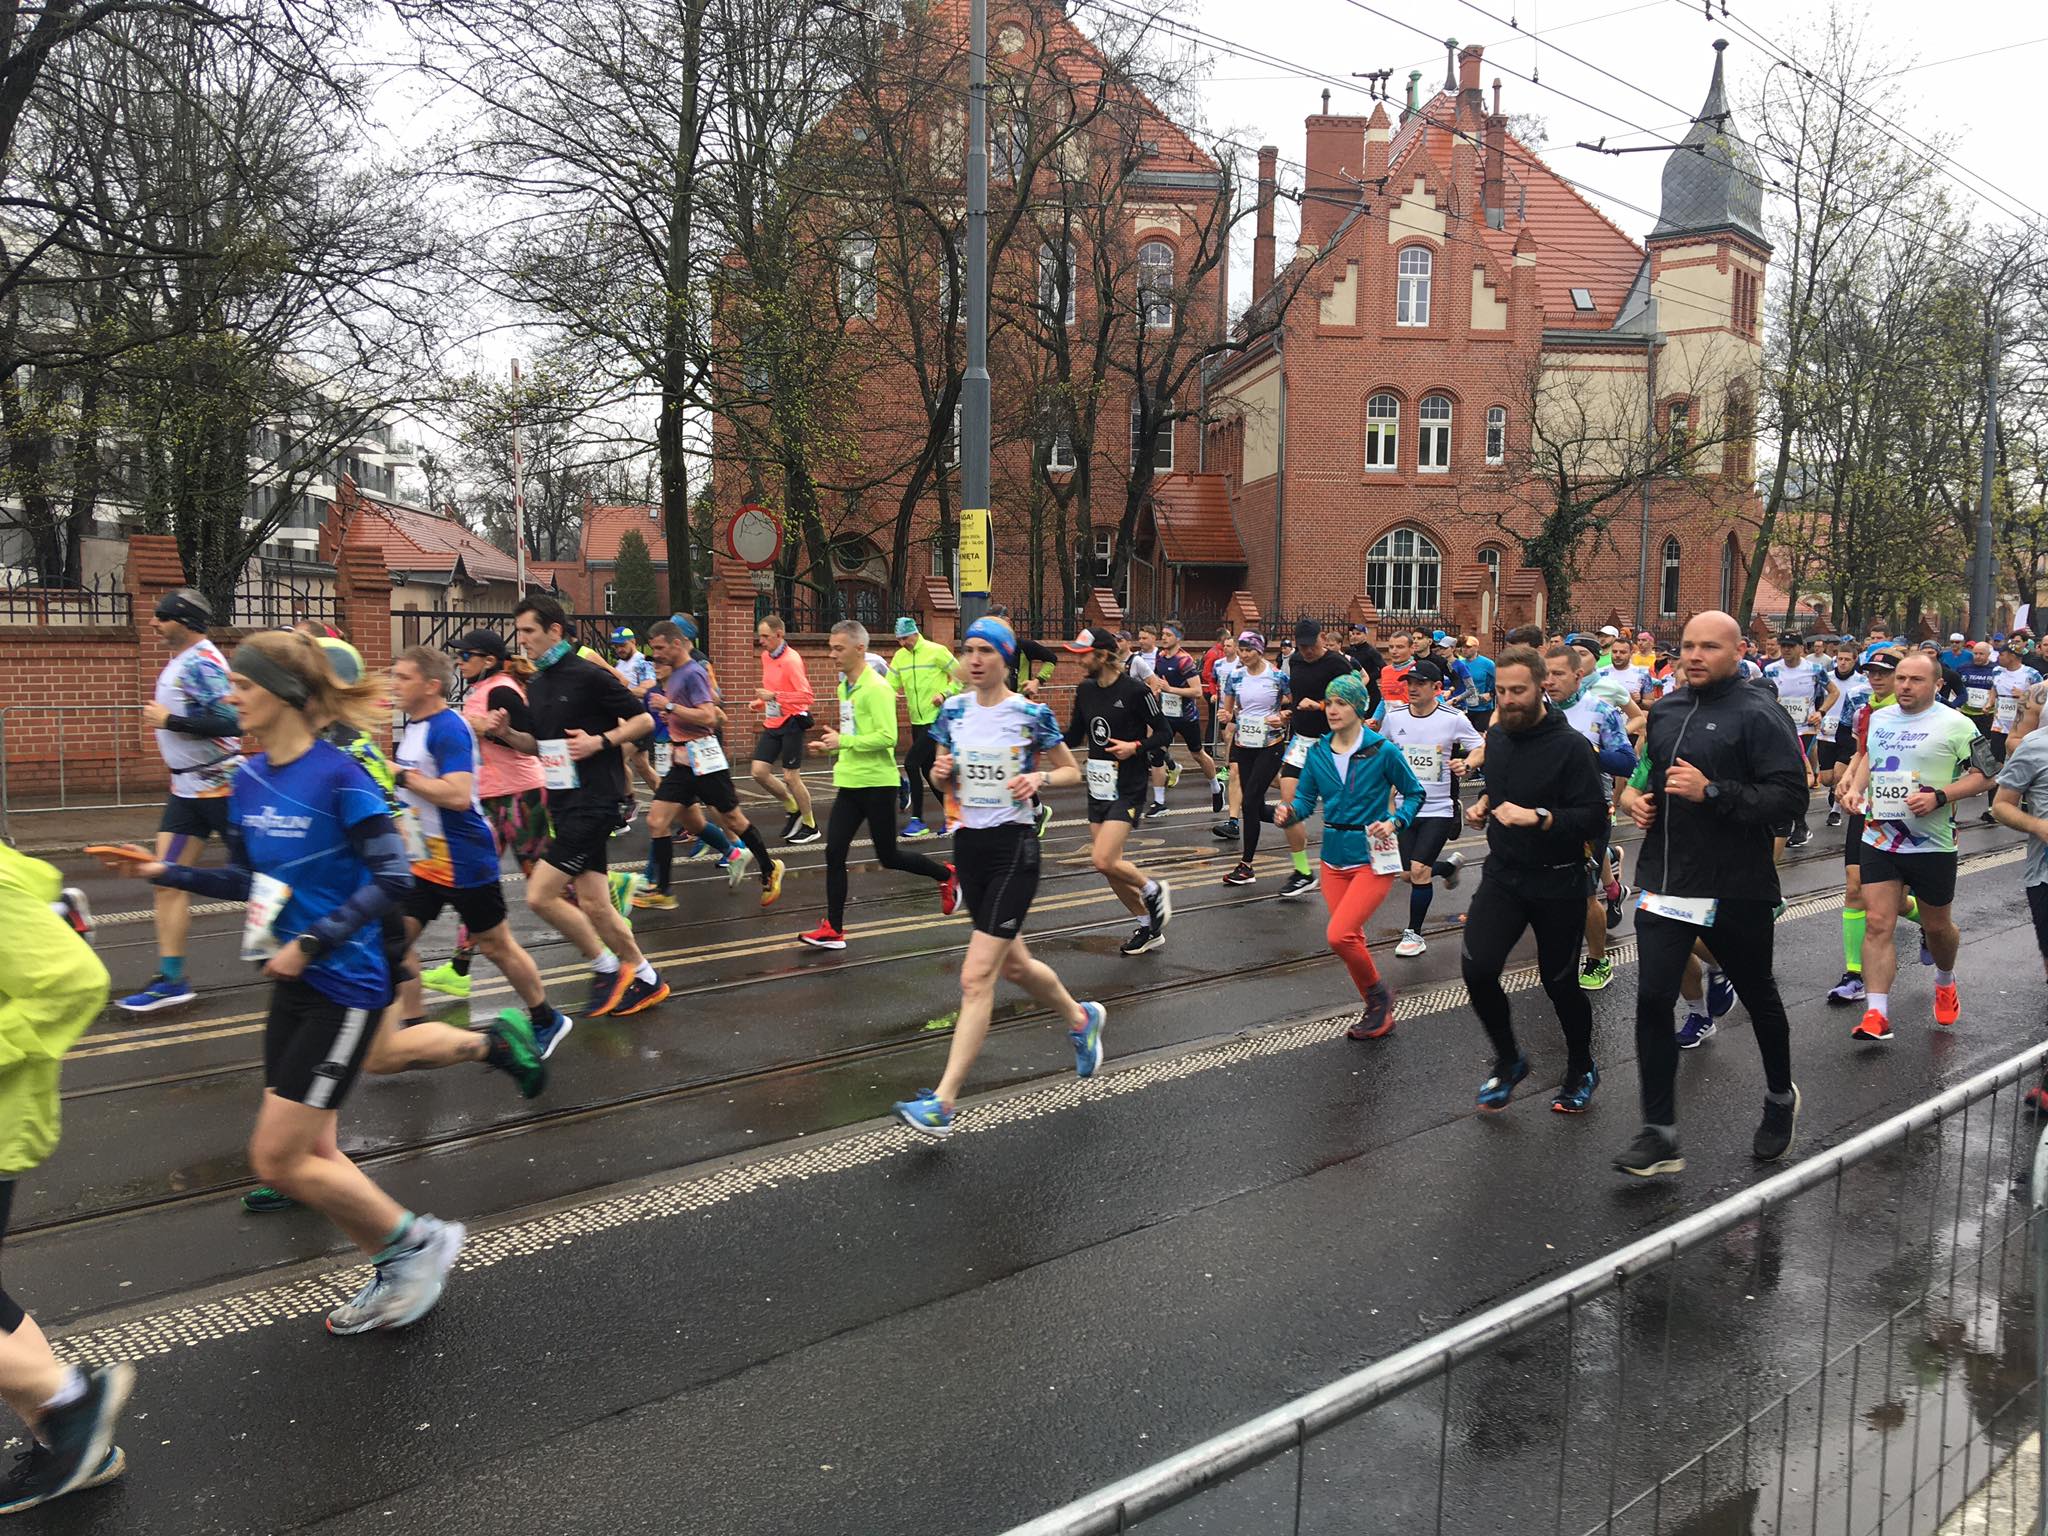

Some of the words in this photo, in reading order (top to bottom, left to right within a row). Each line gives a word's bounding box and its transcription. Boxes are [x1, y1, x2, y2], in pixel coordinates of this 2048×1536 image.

[1241, 725, 1262, 734] 5234
[1873, 728, 1895, 739] Run
[1897, 731, 1929, 741] Team
[1408, 756, 1433, 766] 1625
[966, 764, 1006, 780] 3316
[1875, 786, 1909, 799] 5482
